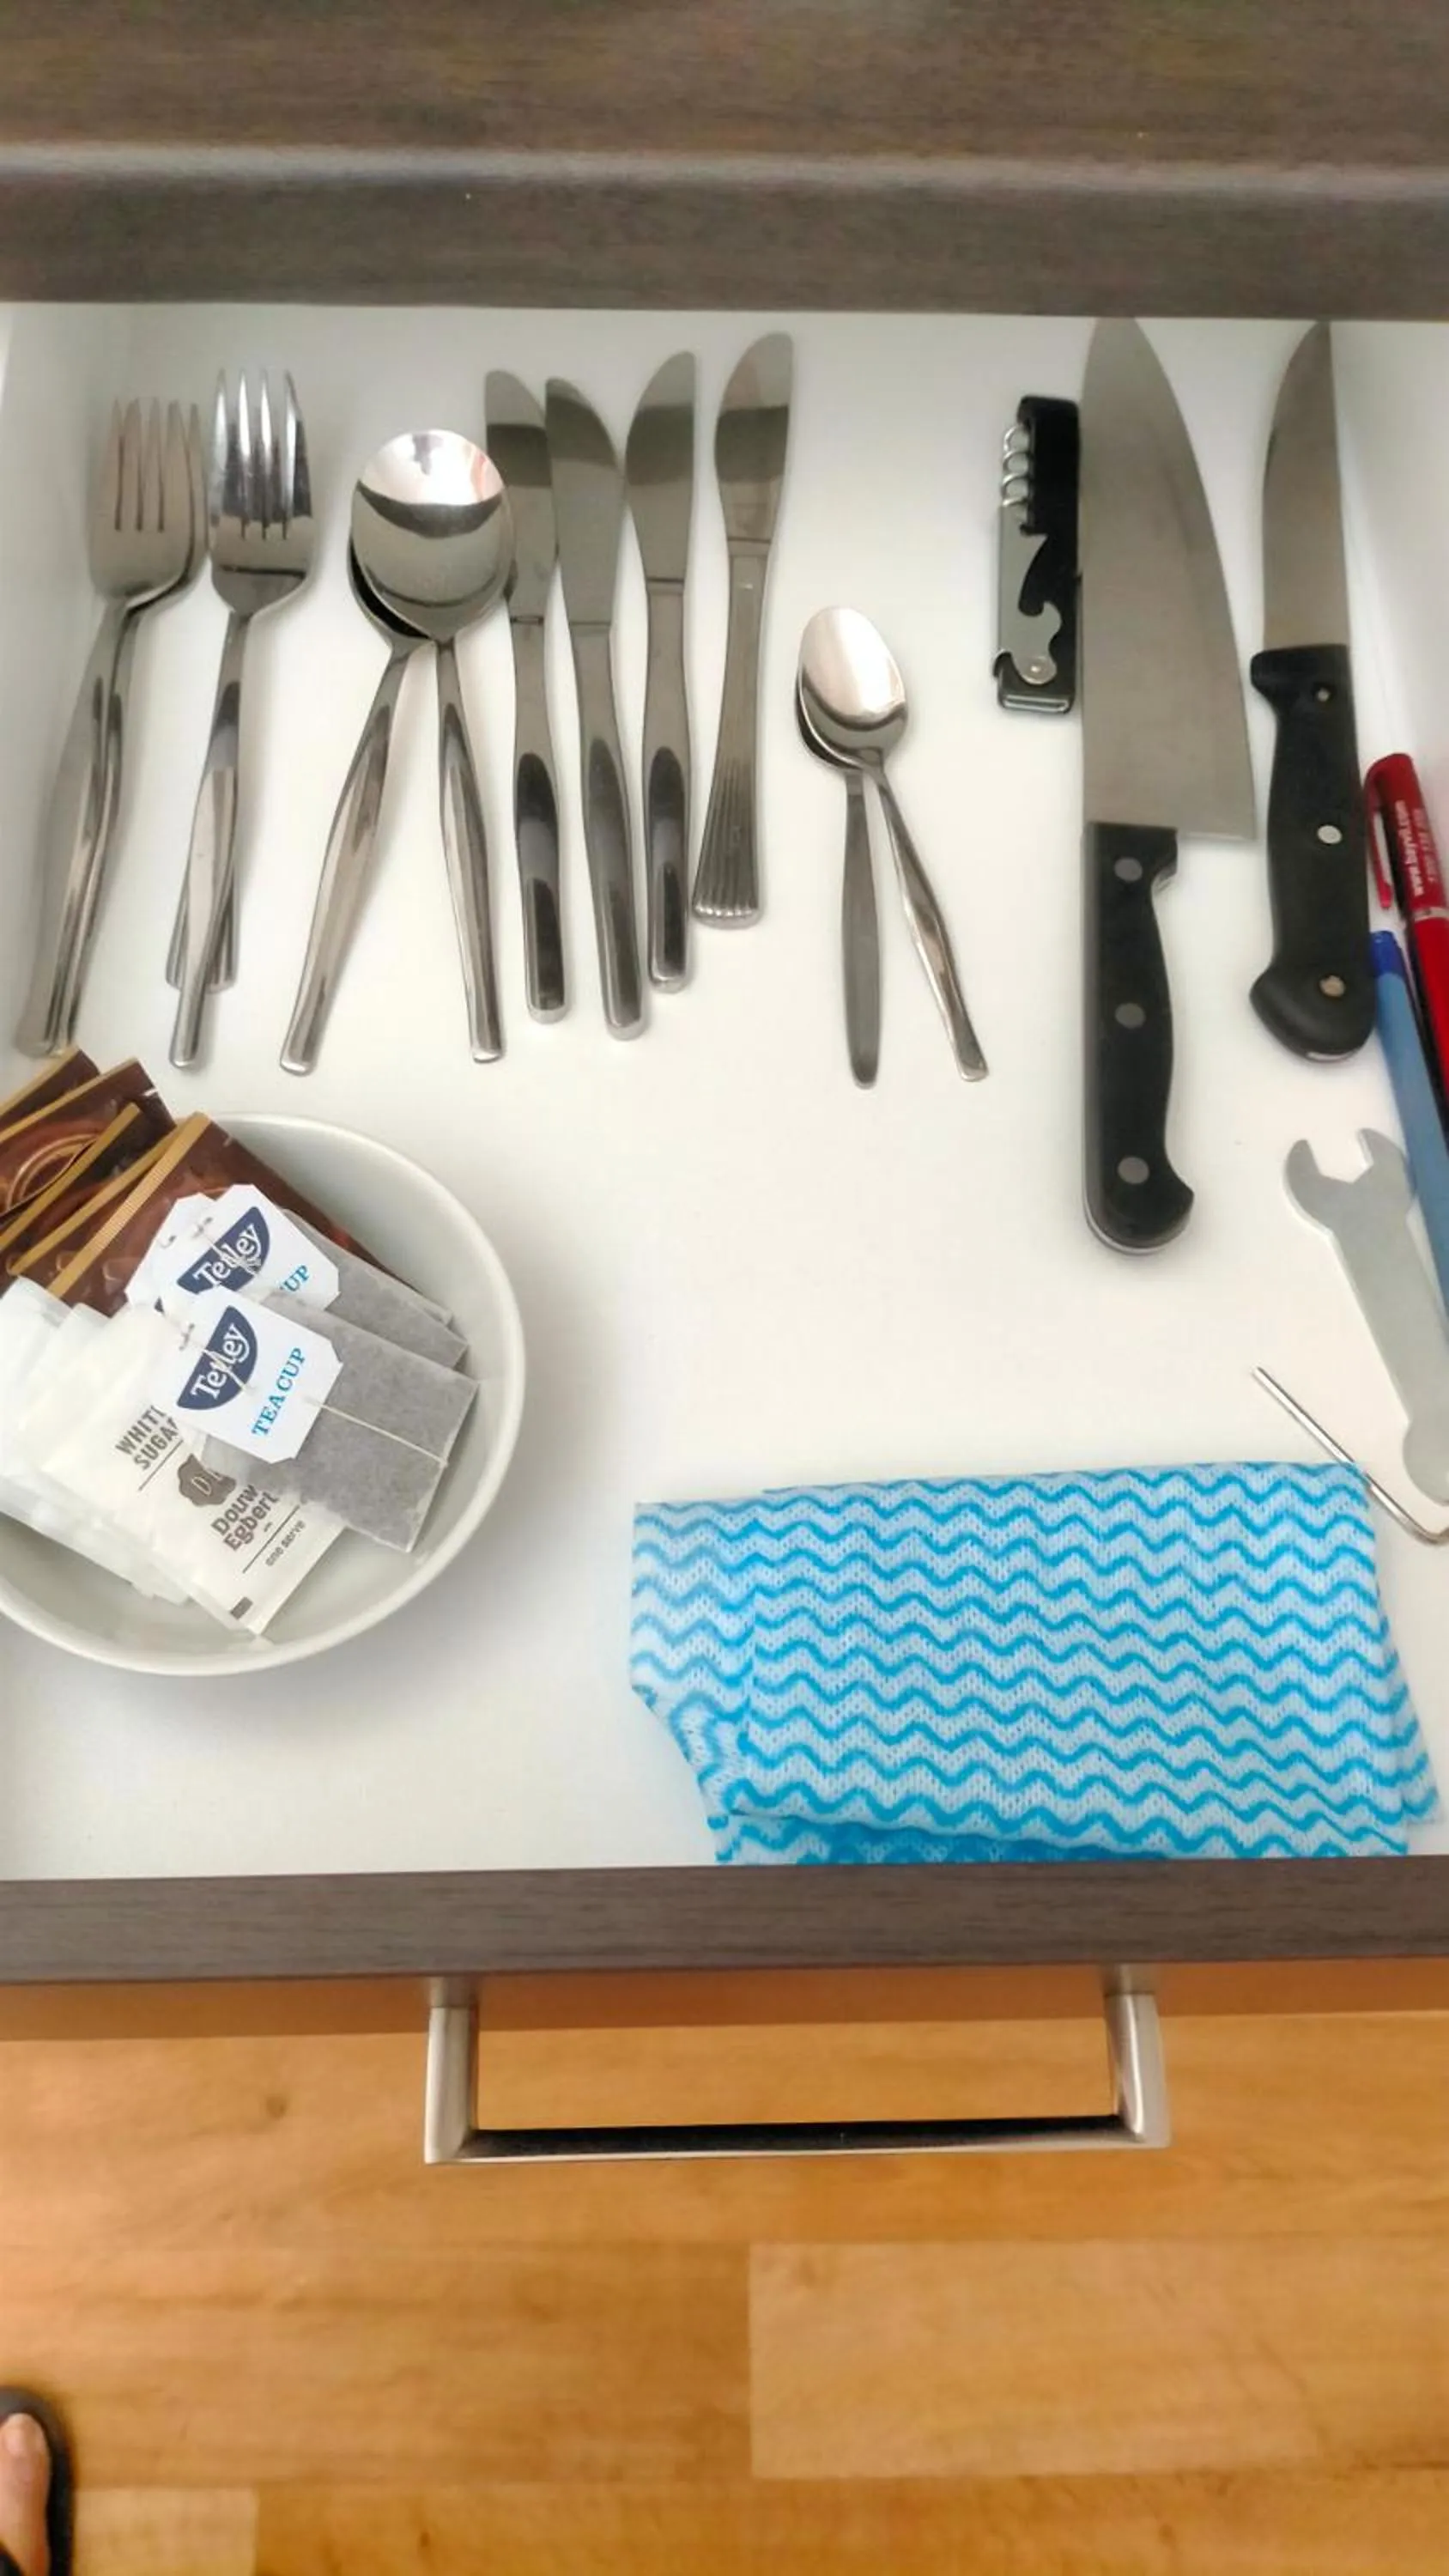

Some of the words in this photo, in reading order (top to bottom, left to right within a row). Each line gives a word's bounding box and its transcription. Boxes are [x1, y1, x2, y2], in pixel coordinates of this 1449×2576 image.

[279, 1265, 310, 1292] UP
[190, 1322, 251, 1400] Tetley
[133, 1417, 179, 1470] SUGA
[265, 1546, 284, 1566] one
[281, 1521, 306, 1549] serve
